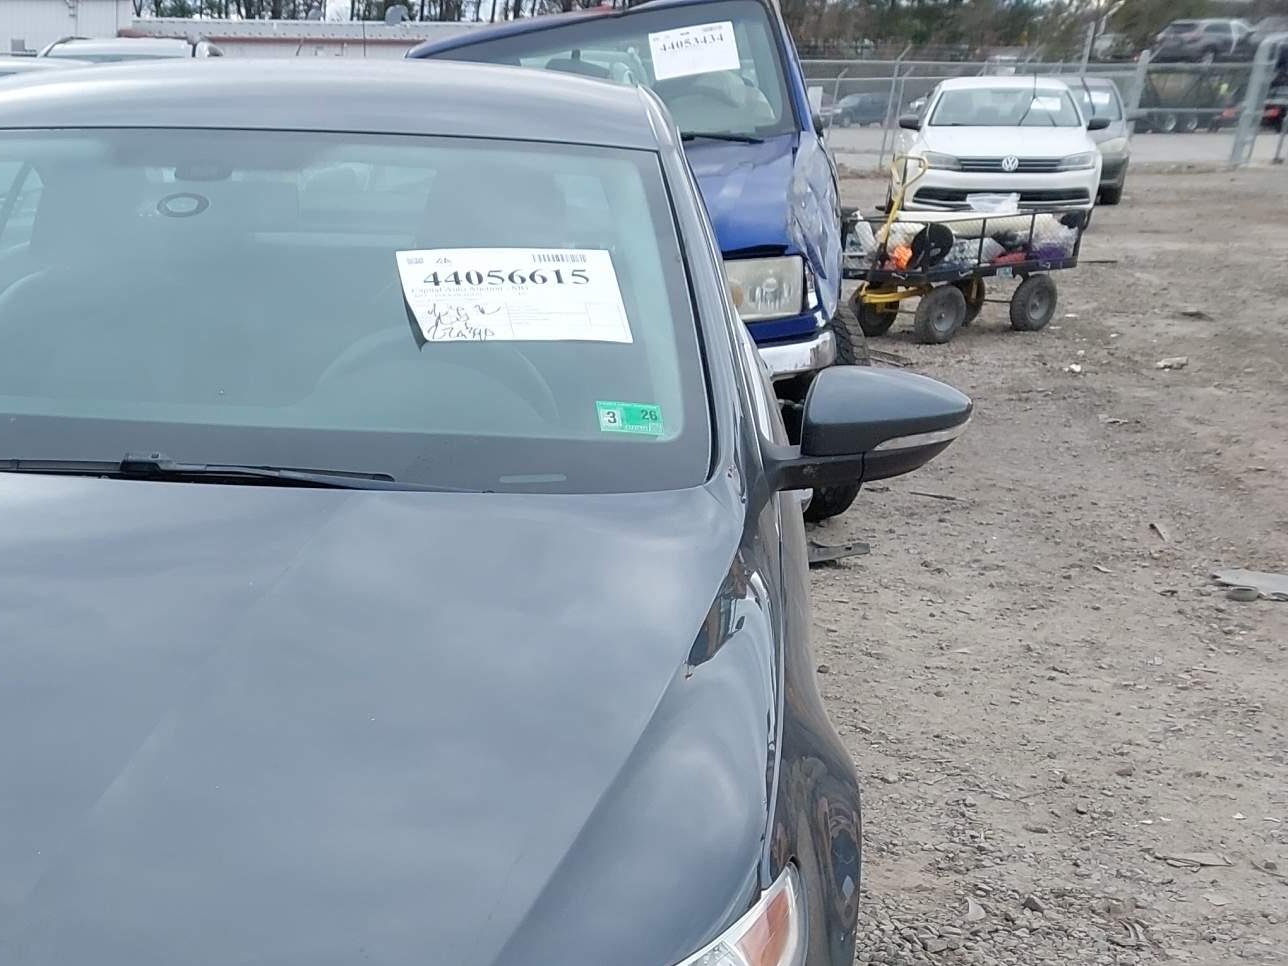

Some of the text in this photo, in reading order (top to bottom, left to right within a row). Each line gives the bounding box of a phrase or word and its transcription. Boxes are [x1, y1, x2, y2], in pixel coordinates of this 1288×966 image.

[423, 268, 590, 287] 44056615
[606, 409, 658, 424] 3 26
